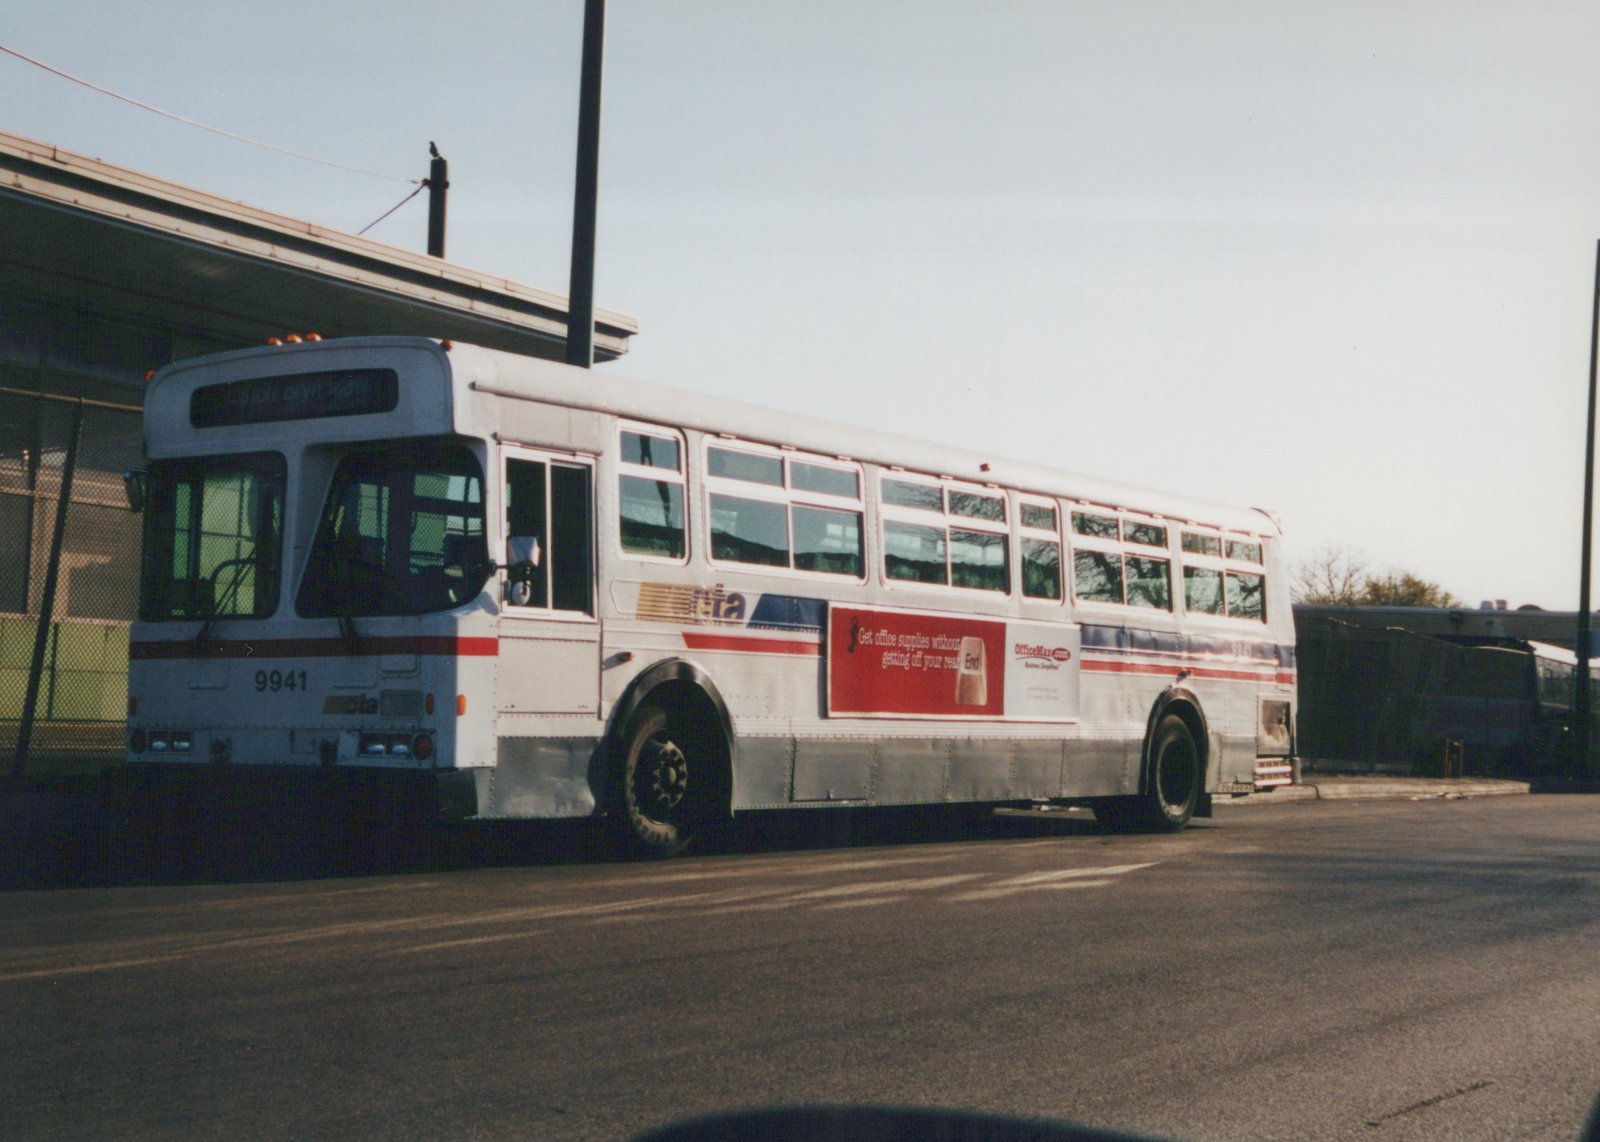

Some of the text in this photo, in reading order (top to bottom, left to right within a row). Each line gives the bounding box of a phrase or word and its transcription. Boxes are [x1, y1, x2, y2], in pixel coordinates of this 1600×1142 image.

[859, 628, 873, 645] Get
[875, 630, 896, 647] office
[898, 632, 930, 651] supplies
[882, 651, 911, 670] getting
[911, 651, 923, 667] off
[924, 655, 942, 671] your
[965, 653, 980, 670] End
[254, 670, 307, 692] 9941
